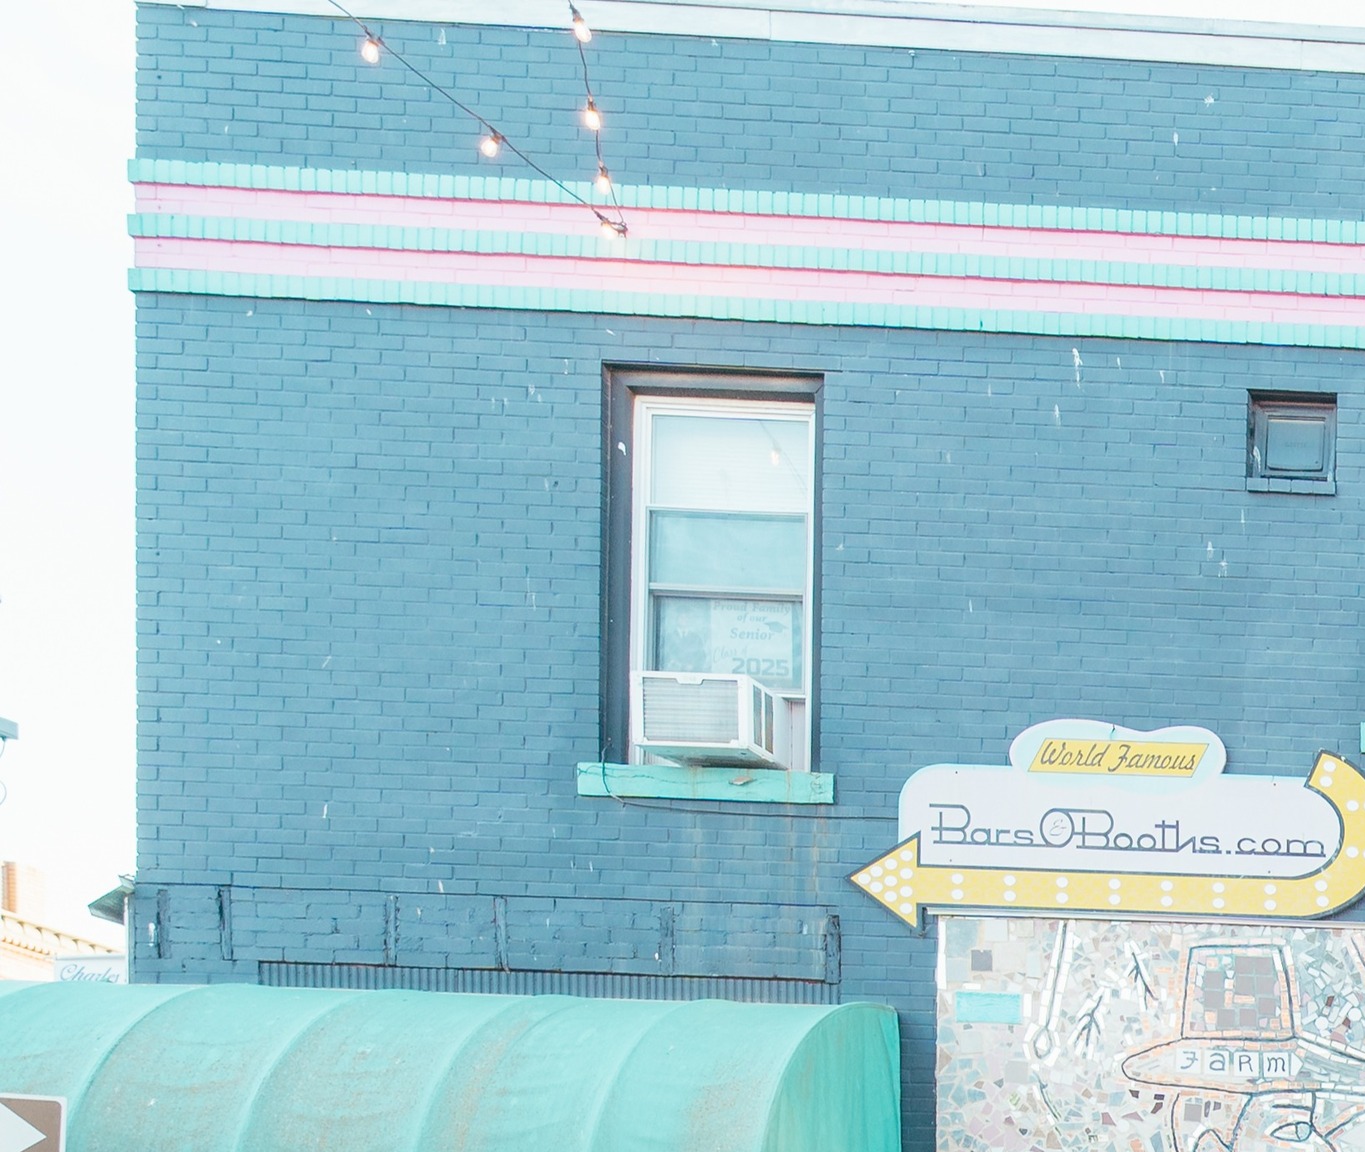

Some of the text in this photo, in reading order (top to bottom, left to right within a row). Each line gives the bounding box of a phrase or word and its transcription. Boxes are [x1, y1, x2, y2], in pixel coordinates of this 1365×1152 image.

[713, 600, 791, 616] Proud Family
[730, 627, 775, 641] Senior
[732, 657, 790, 677] 2025
[1040, 741, 1196, 772] World Famous
